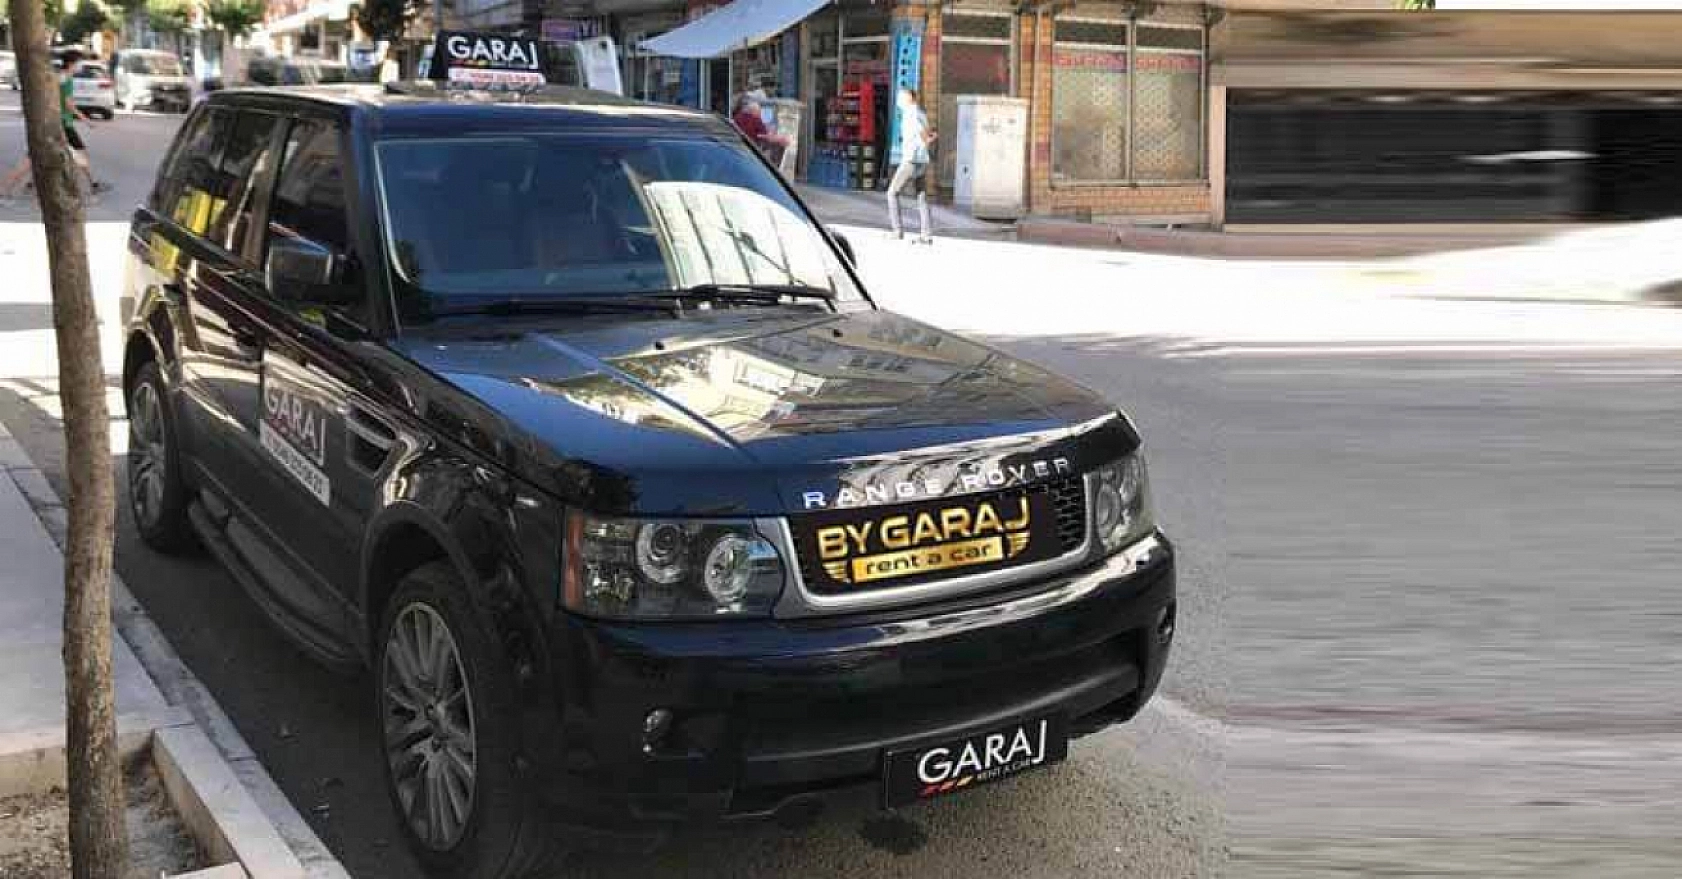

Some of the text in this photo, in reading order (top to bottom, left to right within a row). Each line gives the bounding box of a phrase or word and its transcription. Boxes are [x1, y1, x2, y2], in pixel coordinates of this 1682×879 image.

[448, 36, 539, 69] GARAJ
[802, 458, 1071, 510] RANGE ROVER
[817, 497, 1031, 560] BY GARAJ
[866, 543, 993, 575] rent a car
[918, 719, 1047, 783] GARAJ
